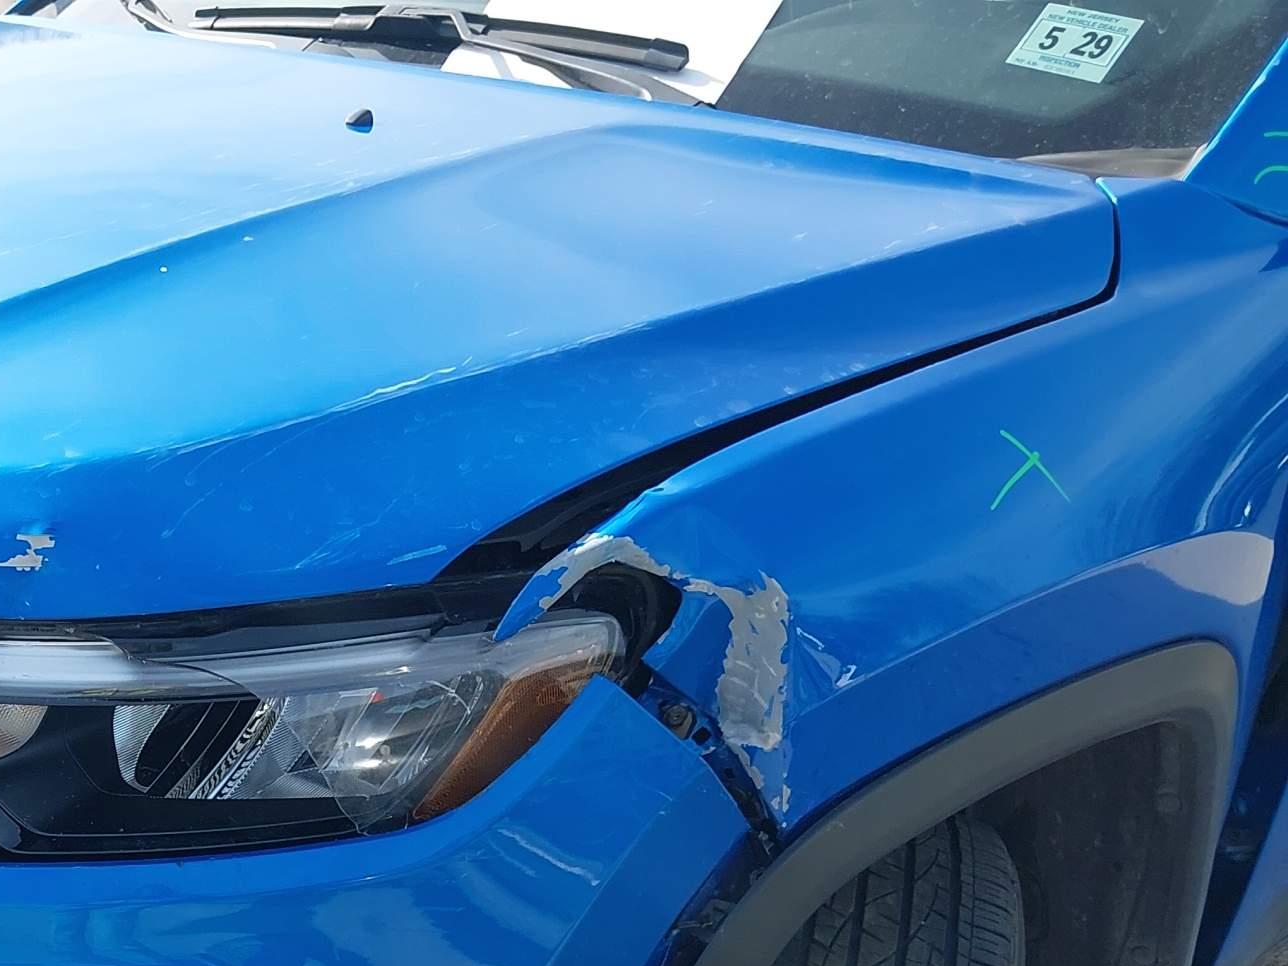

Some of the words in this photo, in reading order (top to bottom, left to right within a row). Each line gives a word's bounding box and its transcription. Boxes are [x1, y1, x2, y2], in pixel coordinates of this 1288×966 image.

[1048, 13, 1065, 22] NEW
[1065, 16, 1097, 28] VEHICLE
[1097, 22, 1129, 33] DEALER
[1067, 9, 1085, 18] NEW
[1086, 12, 1120, 23] JERSEY
[1038, 26, 1067, 50] 5
[1070, 31, 1114, 59] 29
